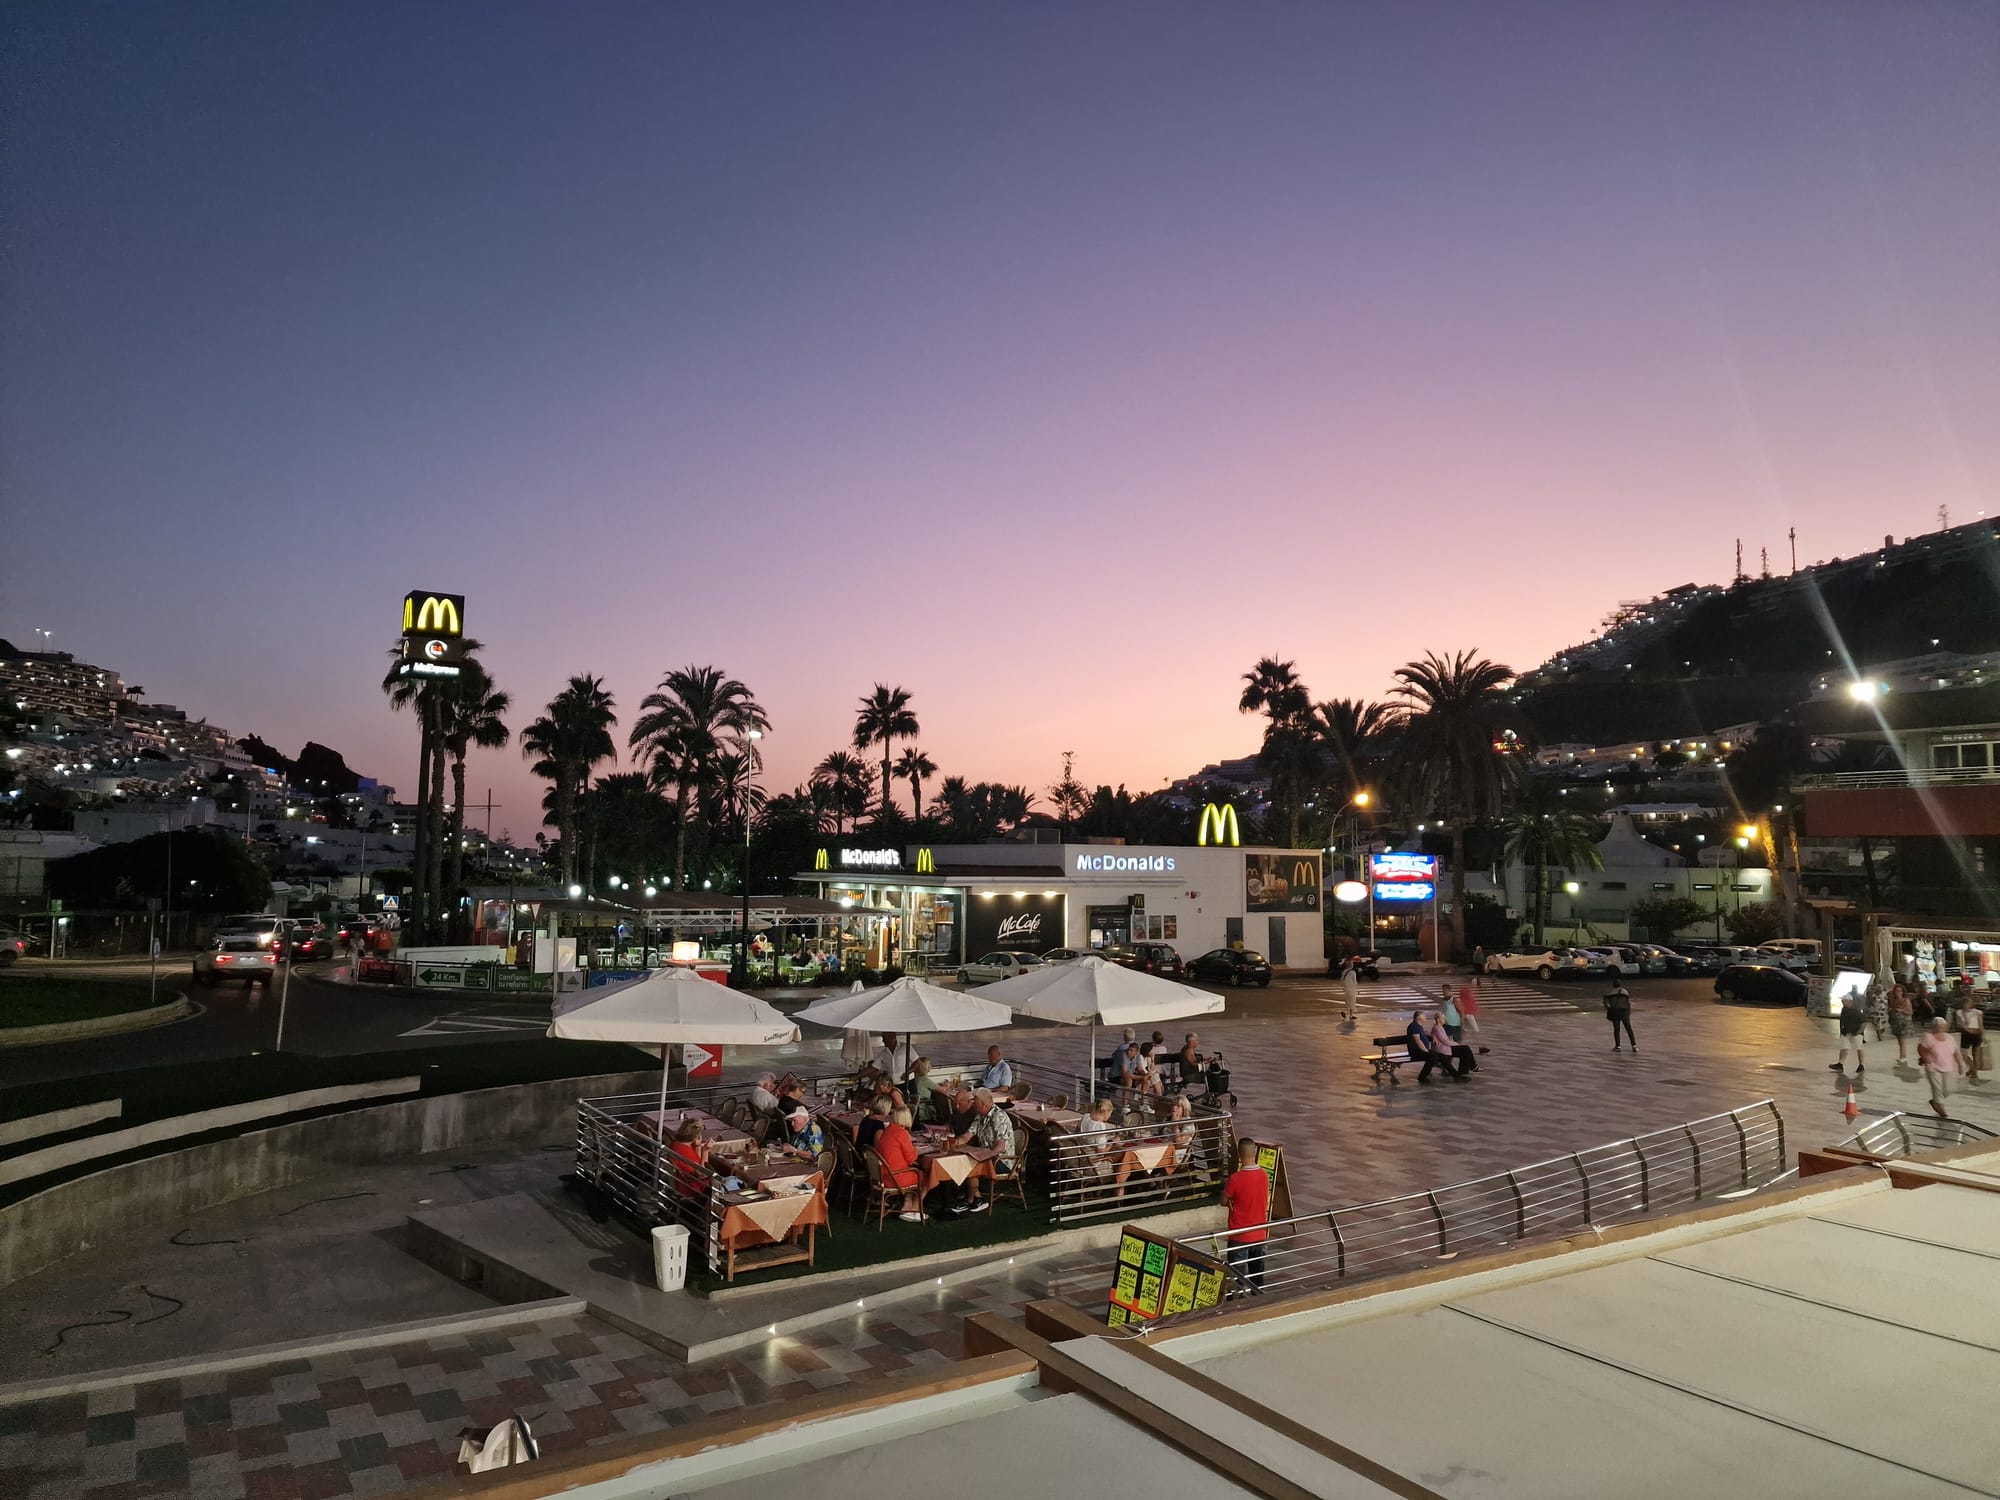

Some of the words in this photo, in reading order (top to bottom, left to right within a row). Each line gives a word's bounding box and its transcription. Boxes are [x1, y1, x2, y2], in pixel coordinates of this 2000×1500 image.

[841, 848, 900, 865] McDonald's
[1076, 854, 1176, 871] McDonald's
[997, 913, 1041, 938] McCafé
[1892, 931, 1964, 941] INTERNATIONAL
[432, 972, 442, 981] 24
